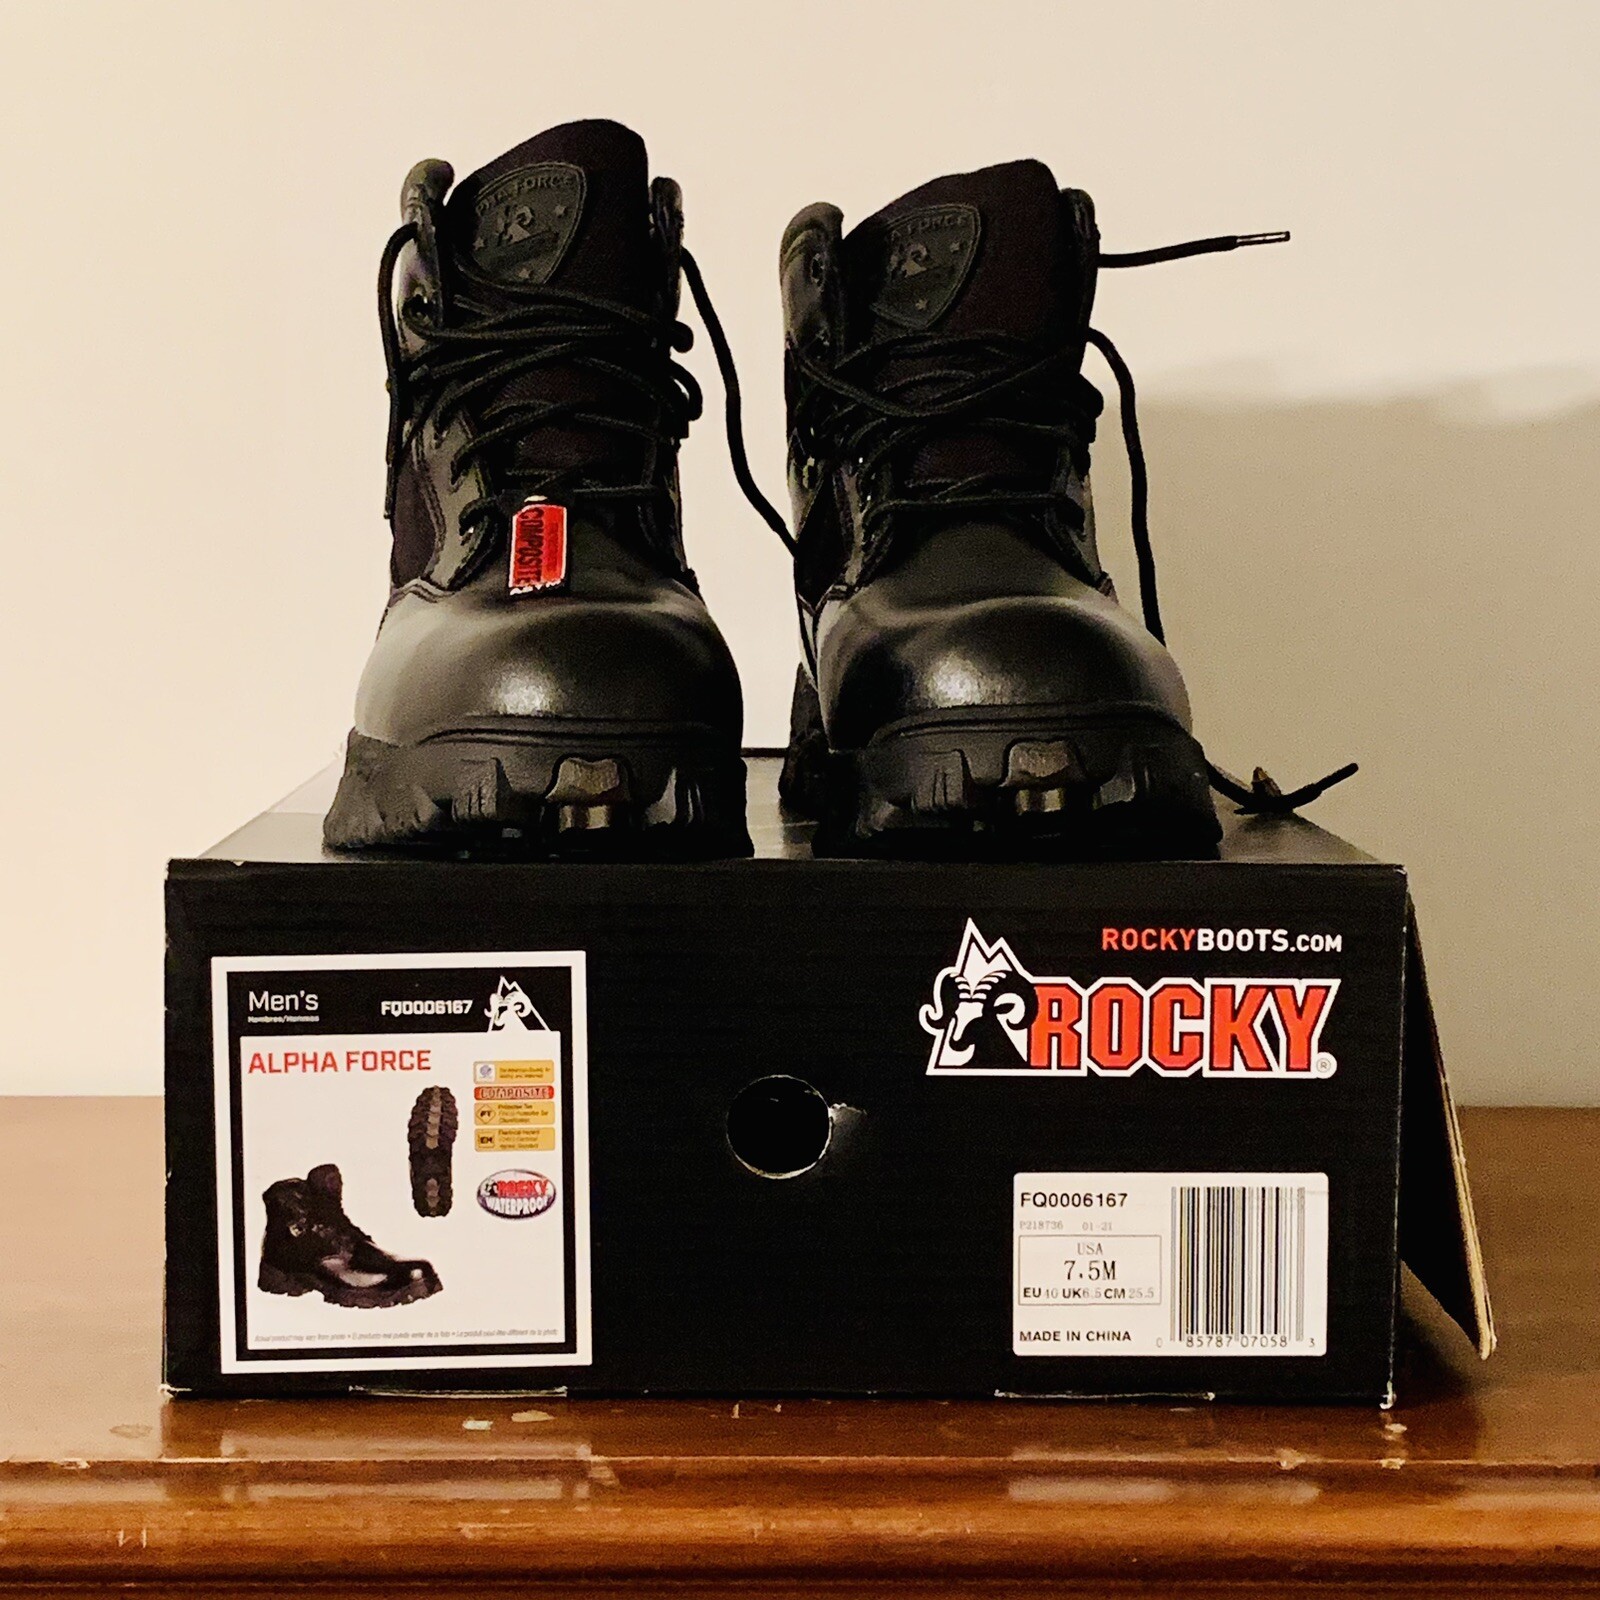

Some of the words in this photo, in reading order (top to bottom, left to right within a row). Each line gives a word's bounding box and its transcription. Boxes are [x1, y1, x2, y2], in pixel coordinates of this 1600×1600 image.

[248, 989, 320, 1013] Men's
[380, 999, 474, 1017] FQ0006167
[1028, 979, 1332, 1076] ROCKY
[248, 1051, 338, 1074] ALPHA
[346, 1050, 432, 1072] FORCE
[486, 1196, 550, 1216] WATERPROOF
[1019, 1191, 1129, 1209] FQ0006167
[1076, 1242, 1104, 1256] USA
[1063, 1260, 1118, 1281] 7.5M
[1022, 1286, 1042, 1299] EU
[1103, 1287, 1126, 1299] CM
[1019, 1330, 1061, 1341] MADE
[1065, 1330, 1081, 1341] IN
[1085, 1330, 1132, 1341] CHINA
[1185, 1335, 1234, 1348] 85787
[1239, 1335, 1289, 1348] 07058
